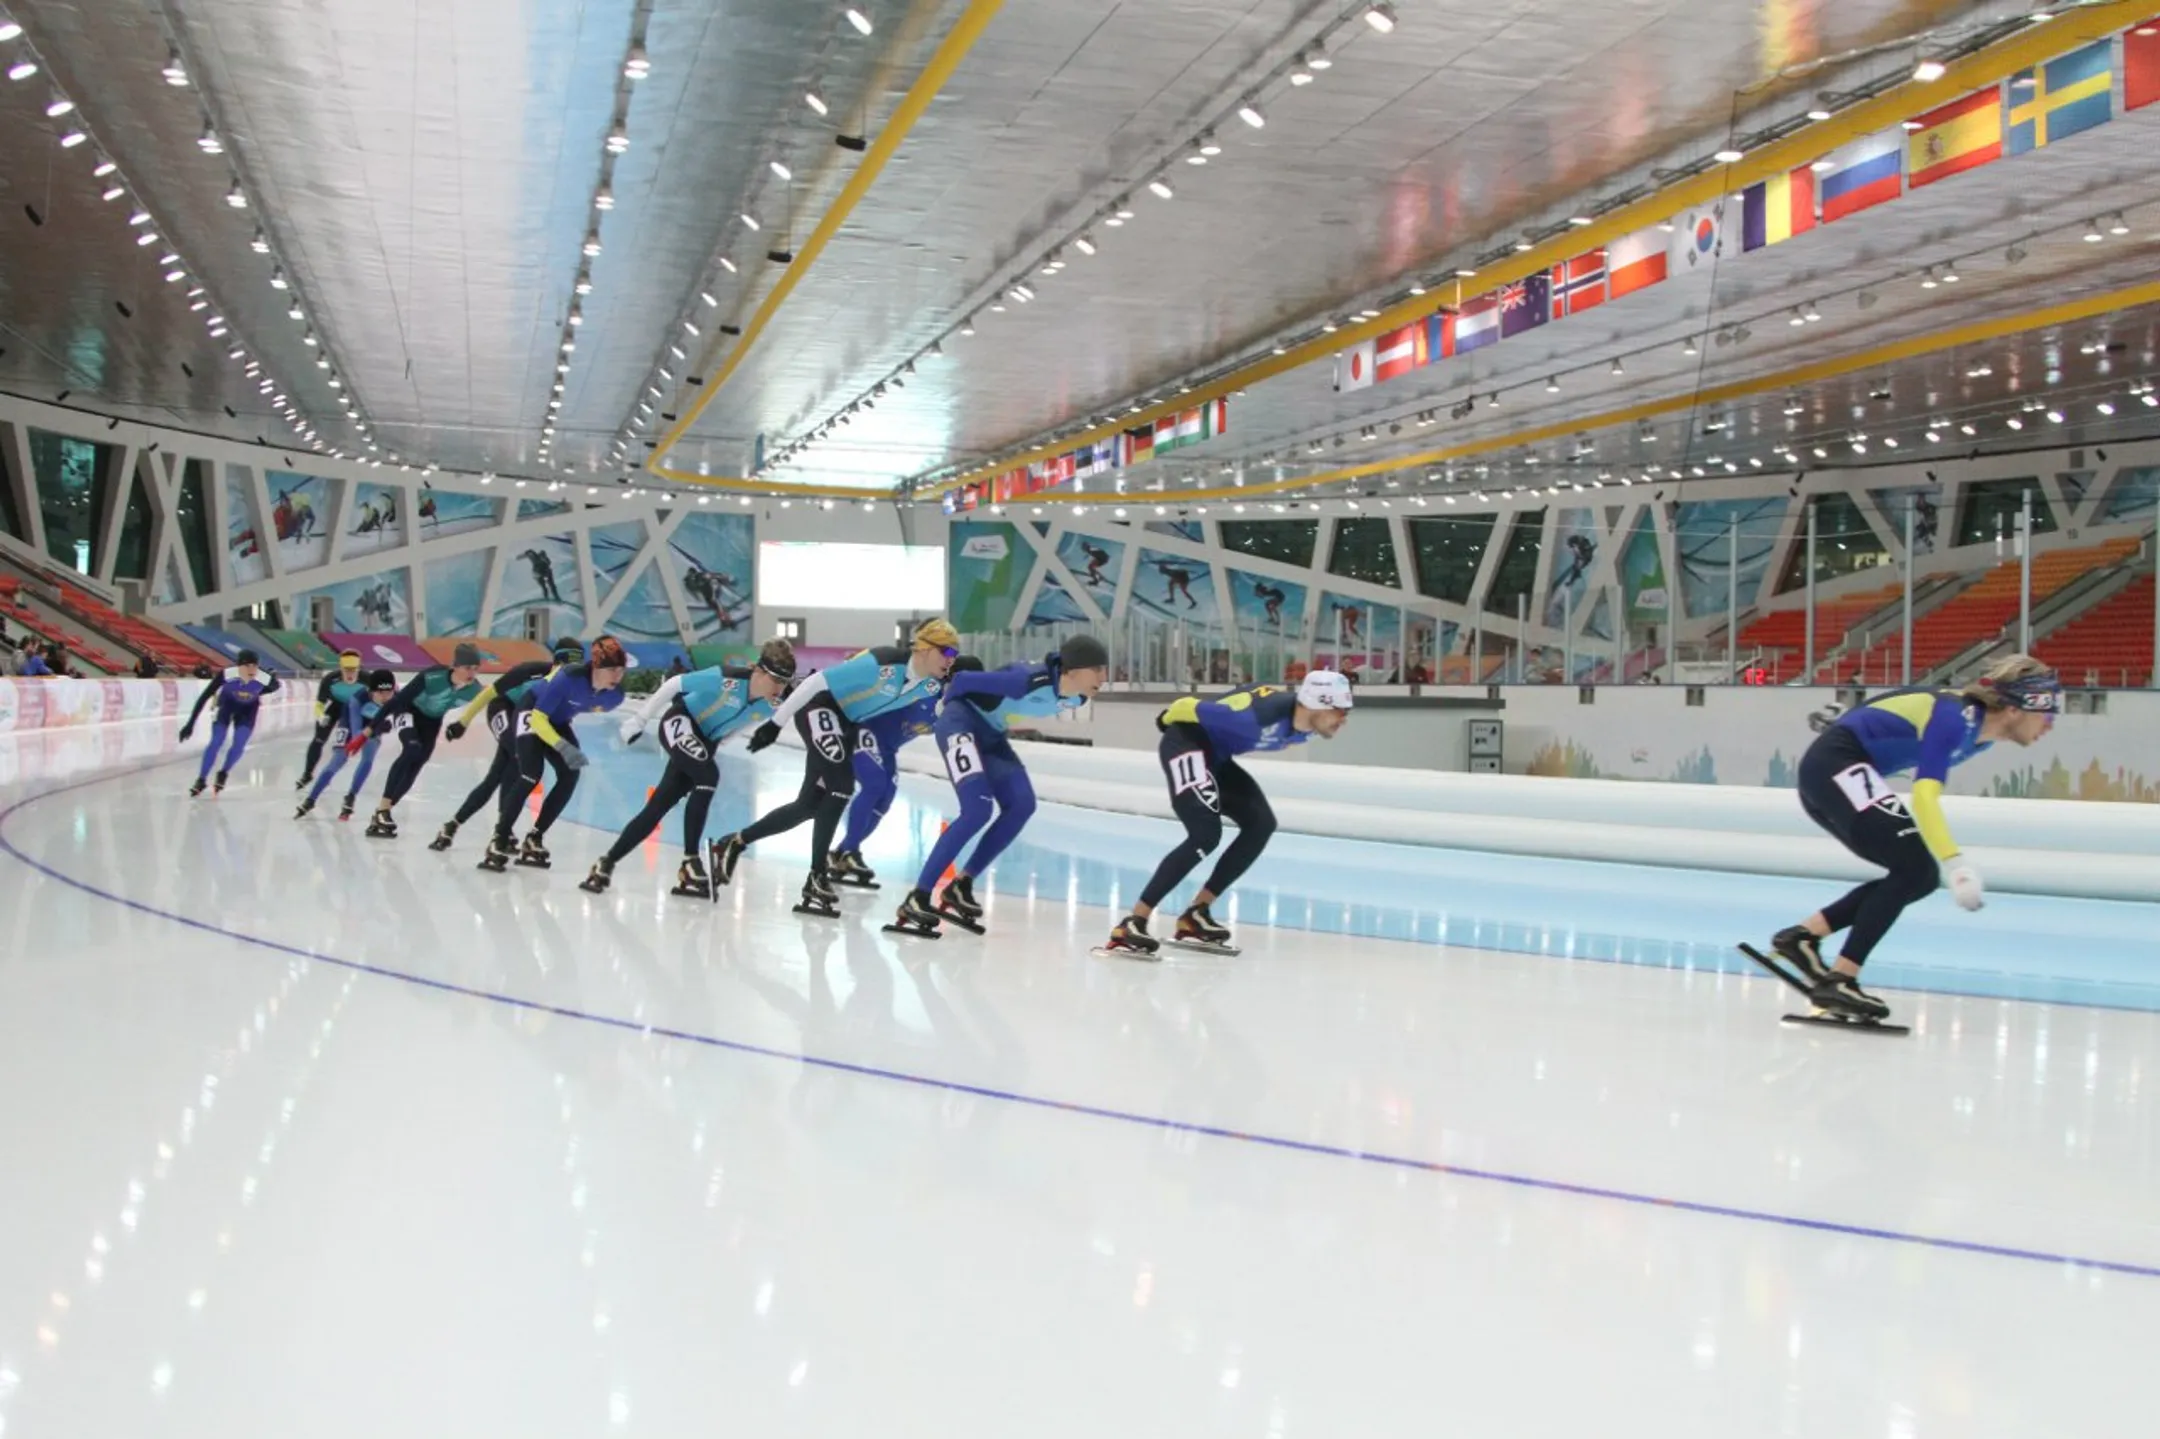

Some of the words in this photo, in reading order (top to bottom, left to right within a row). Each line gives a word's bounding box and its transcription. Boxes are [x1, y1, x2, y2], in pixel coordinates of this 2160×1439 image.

[671, 719, 682, 739] 2
[818, 711, 833, 732] 8
[862, 732, 874, 749] 6
[955, 748, 972, 774] 6
[1177, 754, 1196, 787] 11
[1848, 769, 1874, 801] 7
